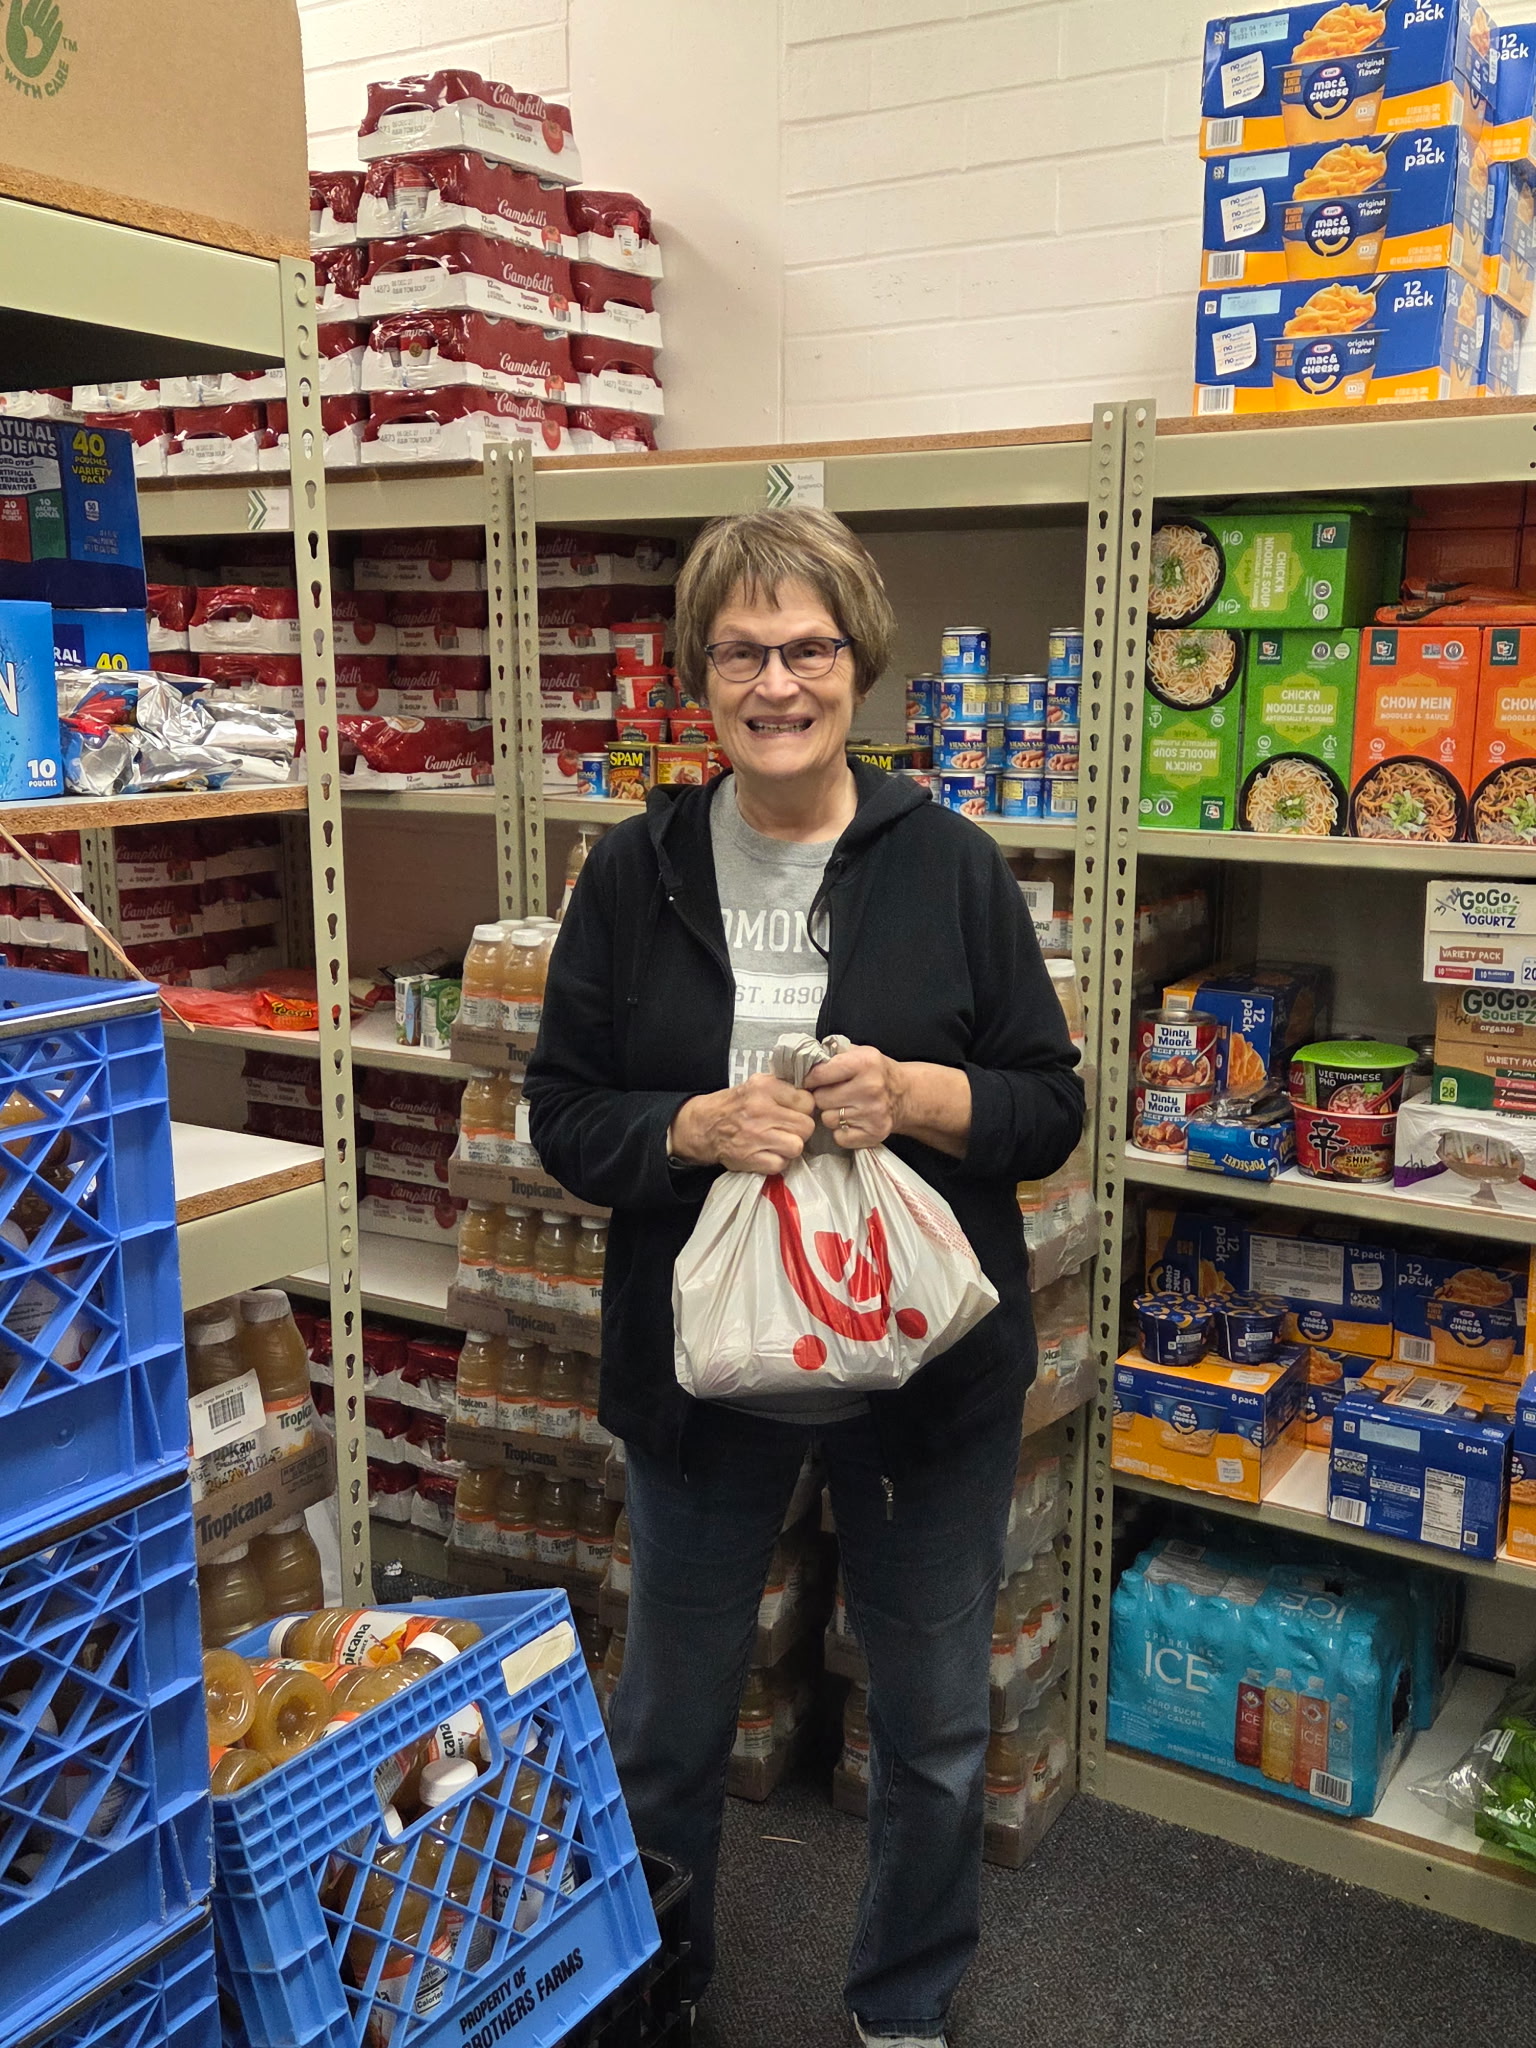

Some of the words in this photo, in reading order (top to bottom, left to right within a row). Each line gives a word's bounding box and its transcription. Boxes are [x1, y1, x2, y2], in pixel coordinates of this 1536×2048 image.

[1404, 8, 1445, 29] pack
[61, 37, 78, 52] TM
[1500, 33, 1517, 49] 12
[1356, 57, 1385, 69] original
[5, 65, 42, 99] WITH
[44, 59, 69, 96] CARE
[1358, 68, 1381, 77] flavor
[1314, 78, 1335, 91] mac
[1335, 77, 1346, 87] &
[491, 84, 547, 119] Campbell's
[1414, 137, 1433, 153] 12
[1404, 148, 1445, 172] pack
[1358, 198, 1386, 210] original
[497, 197, 547, 227] Campbell's
[1360, 208, 1382, 217] flavor
[1315, 218, 1337, 228] mac
[1338, 216, 1348, 226] &
[502, 261, 554, 294] Campbell's
[1404, 280, 1422, 296] 12
[1393, 292, 1434, 312] pack
[1347, 338, 1375, 348] original
[1349, 347, 1372, 355] flavor
[500, 352, 551, 376] Campbell's
[1305, 355, 1327, 365] mac
[495, 393, 546, 420] Campbell's
[72, 429, 105, 457] 40
[74, 456, 107, 466] POUCHES
[71, 465, 112, 476] VARIETY
[81, 475, 105, 484] PACK
[4, 500, 17, 509] 20
[1262, 536, 1275, 578] NOODLE
[1274, 551, 1287, 593] CHICK'N
[1261, 580, 1271, 608] SOUP
[96, 653, 128, 670] 40
[1281, 689, 1320, 701] CHICK'N
[1380, 695, 1418, 709] CHOW
[1420, 696, 1452, 710] MEIN
[1265, 703, 1305, 714] NOODLE
[1307, 704, 1334, 715] SOUP
[1424, 713, 1449, 721] SAUCE
[610, 751, 643, 766] SPAM
[1153, 748, 1177, 759] SOUP
[1178, 748, 1217, 759] NOODLE
[27, 758, 56, 779] 10
[423, 752, 478, 771] Campbell's
[1165, 761, 1202, 772] CHICK'N
[28, 779, 57, 788] POUCHES
[1460, 889, 1511, 911] GoGo
[120, 901, 175, 920] Campbell's
[1475, 905, 1517, 915] SQUEEZ
[1462, 912, 1516, 928] YOGURTZ
[1442, 950, 1476, 959] VARIETY
[1479, 952, 1501, 960] PACK
[773, 986, 824, 1004] 1890
[1463, 989, 1530, 1013] GoGo
[272, 1001, 313, 1018] Reese's
[1241, 999, 1253, 1032] pack
[1253, 1008, 1265, 1023] 12
[1482, 1009, 1536, 1024] SQUEEZ
[1160, 1027, 1189, 1039] Dinty
[1480, 1024, 1515, 1034] organic
[1158, 1036, 1192, 1046] Moore
[1172, 1048, 1198, 1056] STEW
[1486, 1055, 1520, 1066] VARIETY
[1318, 1069, 1381, 1082] VIETNAMESE
[1319, 1078, 1336, 1087] PHO
[1151, 1093, 1178, 1106] Dinty
[1442, 1087, 1455, 1098] 28
[1148, 1103, 1181, 1113] Moore
[1163, 1114, 1188, 1122] STEW
[1346, 1155, 1370, 1164] SHIN
[509, 1176, 564, 1200] Tropicana
[1213, 1226, 1229, 1262] pack
[1227, 1237, 1239, 1251] 12
[1349, 1248, 1359, 1257] 12
[1361, 1250, 1385, 1260] pack
[1406, 1263, 1422, 1274] 12
[1398, 1274, 1432, 1287] pack
[504, 1308, 557, 1335] Tropicana
[1453, 1317, 1473, 1326] mac
[1238, 1396, 1259, 1406] pack
[1175, 1411, 1190, 1420] mac
[502, 1442, 557, 1466] Tropicana
[1465, 1444, 1488, 1456] pack
[197, 1491, 275, 1547] Tropicana
[1279, 1592, 1347, 1624] ICE
[1145, 1641, 1211, 1694] ICE
[1173, 1705, 1202, 1718] SUCRE
[1241, 1712, 1261, 1727] ICE
[1269, 1720, 1291, 1737] ICE
[1301, 1729, 1323, 1747] ICE
[535, 1947, 584, 2002] FARMS
[417, 1991, 444, 2008] Calories
[459, 1978, 512, 2035] PROPERTY
[513, 1966, 527, 1989] OF
